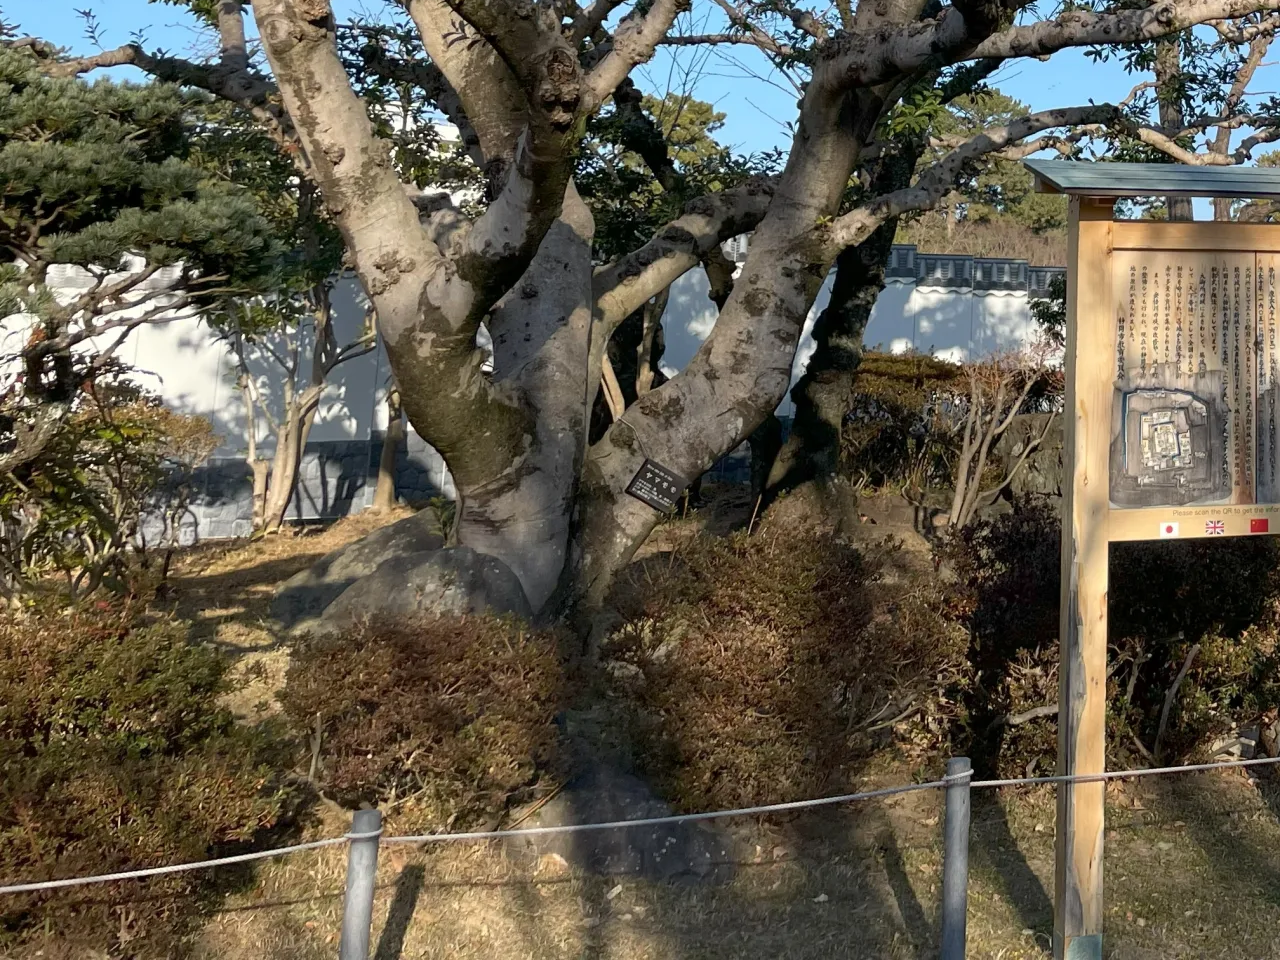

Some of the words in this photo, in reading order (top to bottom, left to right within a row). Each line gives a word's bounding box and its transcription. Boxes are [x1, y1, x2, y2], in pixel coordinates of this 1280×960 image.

[646, 472, 677, 494] ヤマモモ
[1222, 507, 1233, 515] QR
[1242, 508, 1253, 516] get
